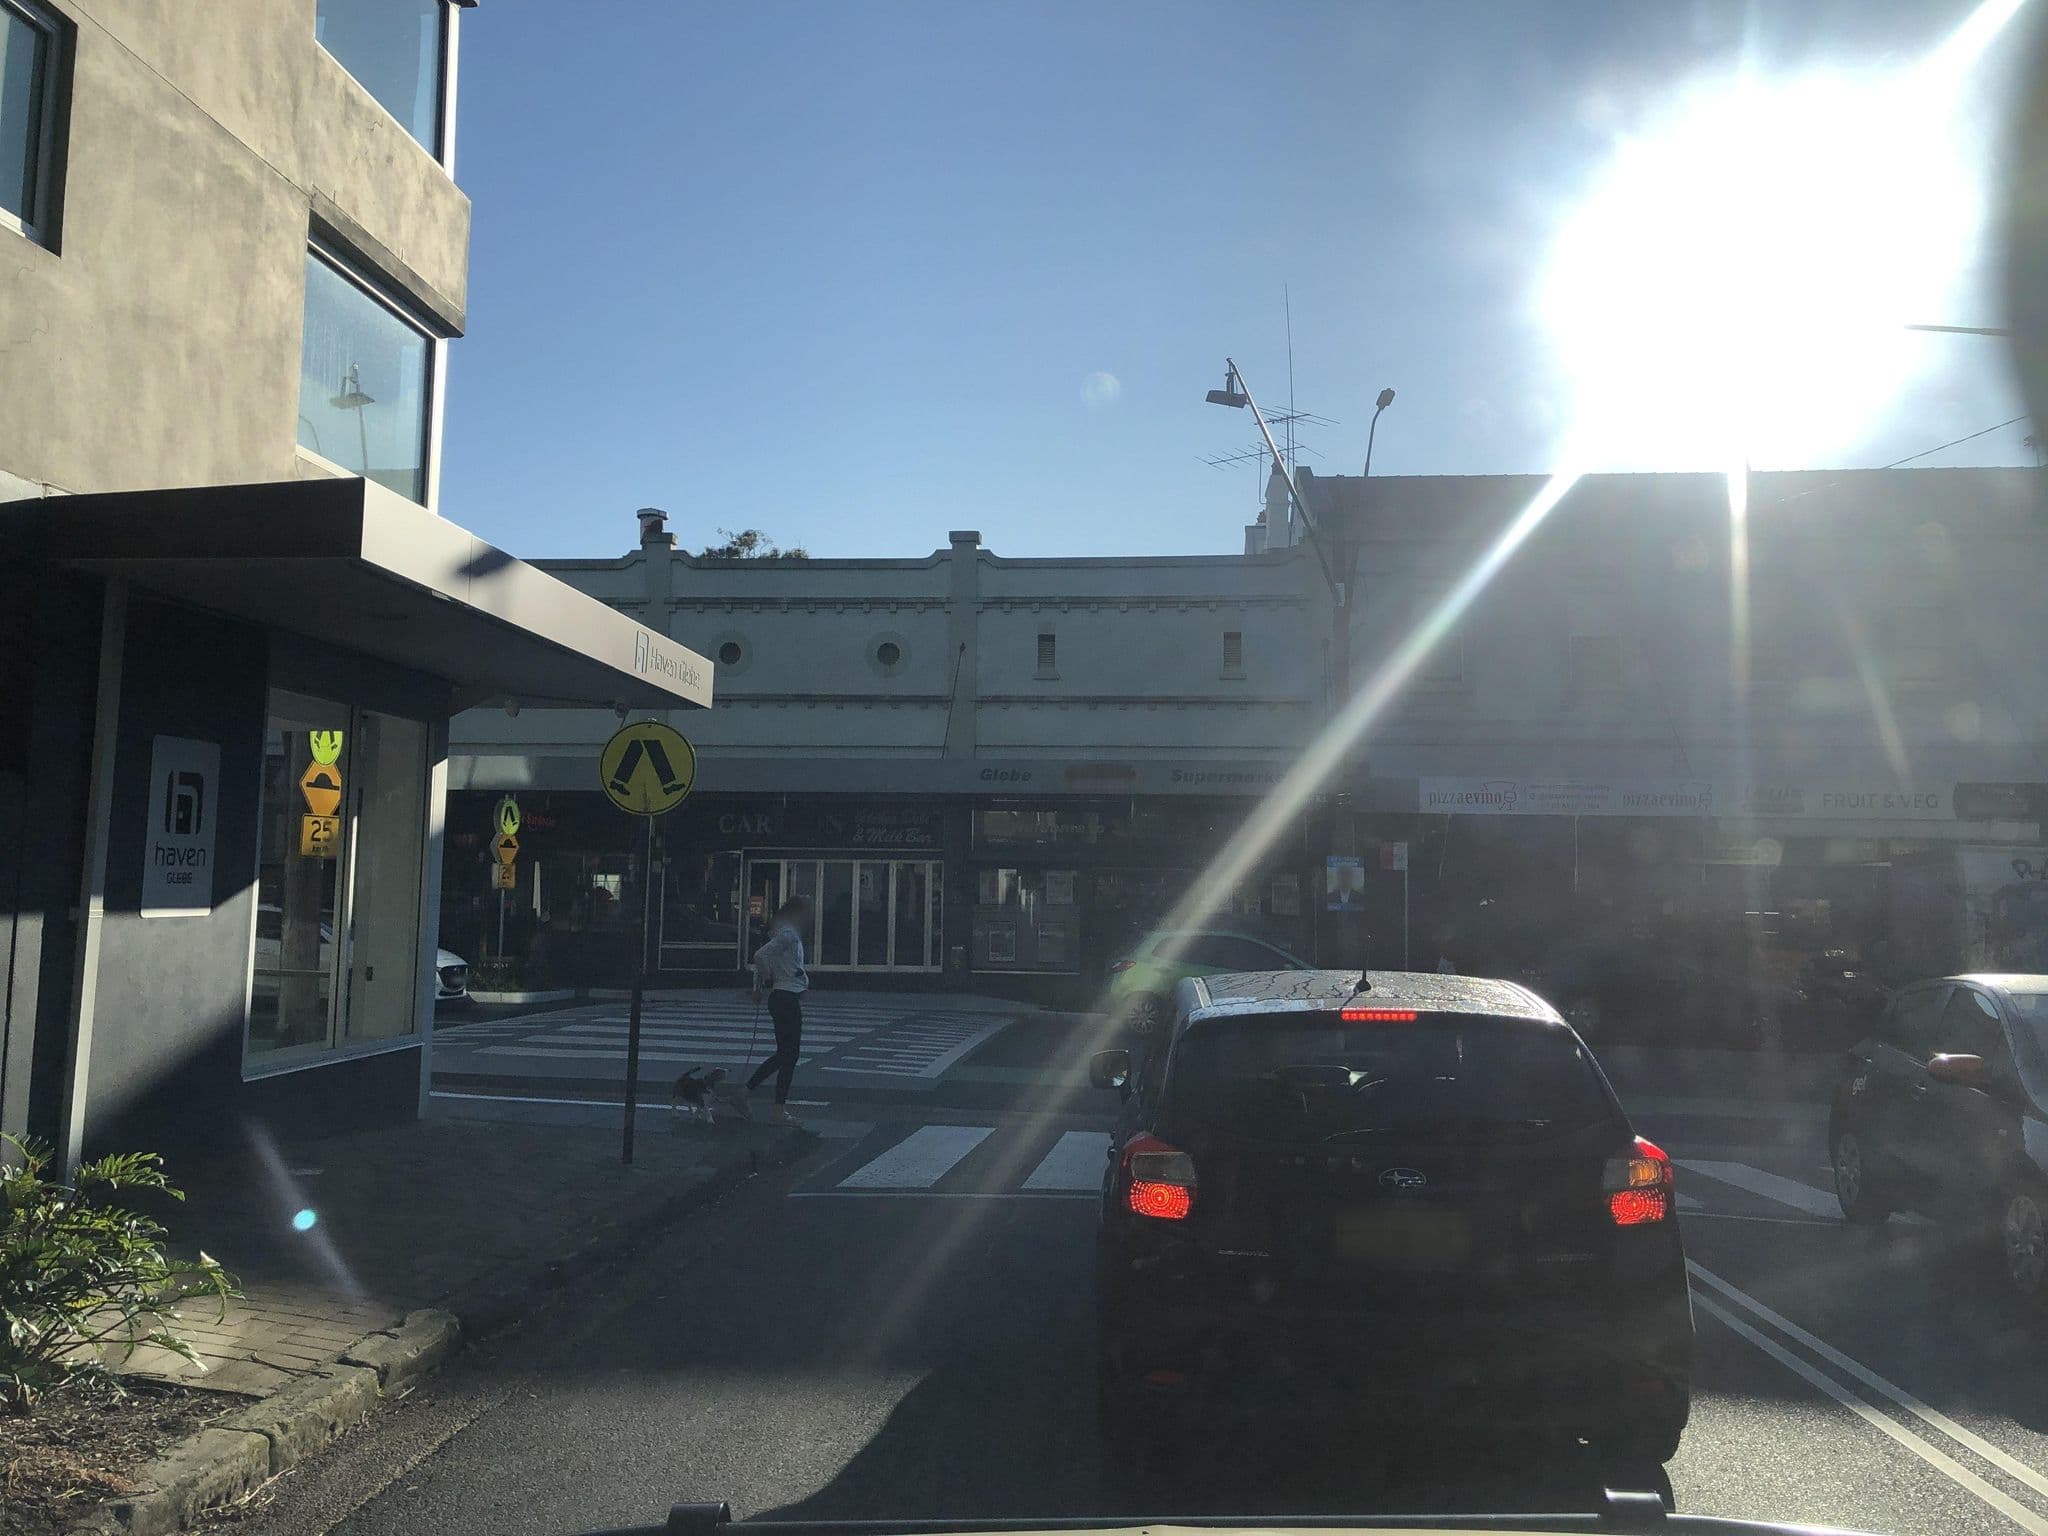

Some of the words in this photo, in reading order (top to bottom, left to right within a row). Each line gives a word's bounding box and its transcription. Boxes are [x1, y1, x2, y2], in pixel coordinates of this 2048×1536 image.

[980, 767, 1032, 782] Glebe
[1822, 793, 1878, 809] FRUIT
[1899, 793, 1939, 809] VEG
[311, 820, 333, 842] 25
[155, 841, 206, 867] haven
[166, 872, 193, 885] GLEBE
